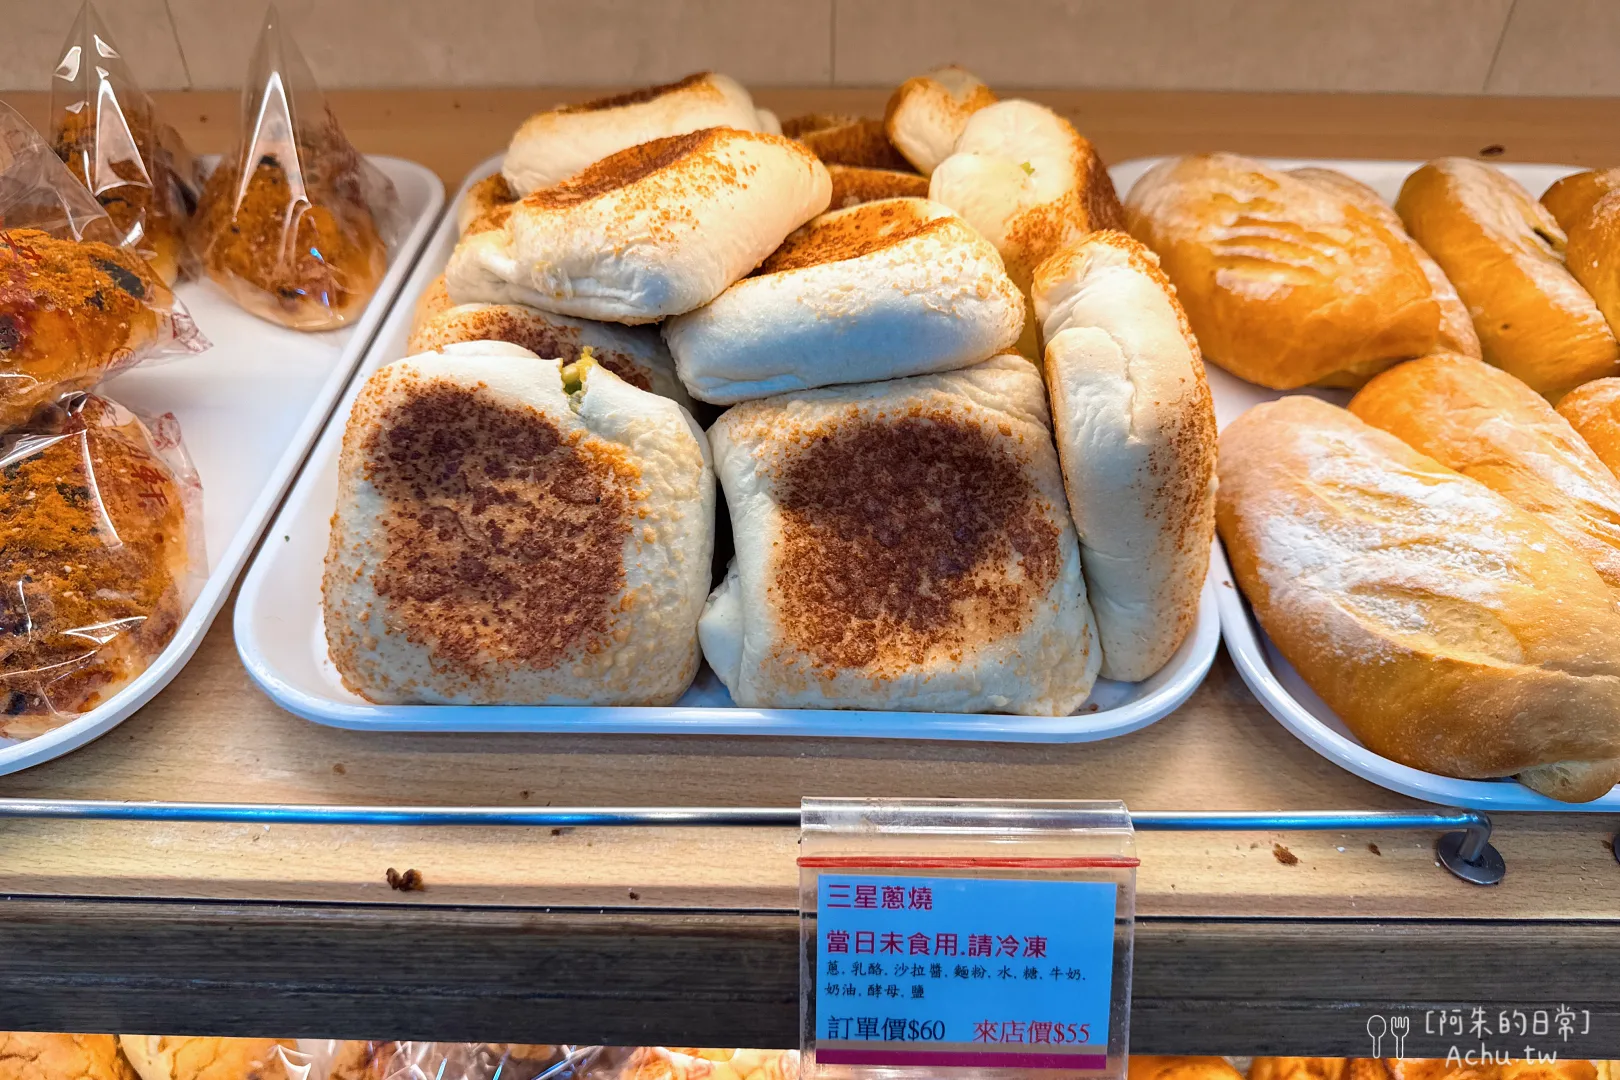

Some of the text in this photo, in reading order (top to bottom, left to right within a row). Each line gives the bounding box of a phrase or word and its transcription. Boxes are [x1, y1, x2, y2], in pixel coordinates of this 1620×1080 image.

[827, 884, 933, 911] 三星蔥燒
[827, 930, 1048, 958] 當日未食用.請冷凍
[828, 1015, 1091, 1045] 訂單價$60 來店價$55
